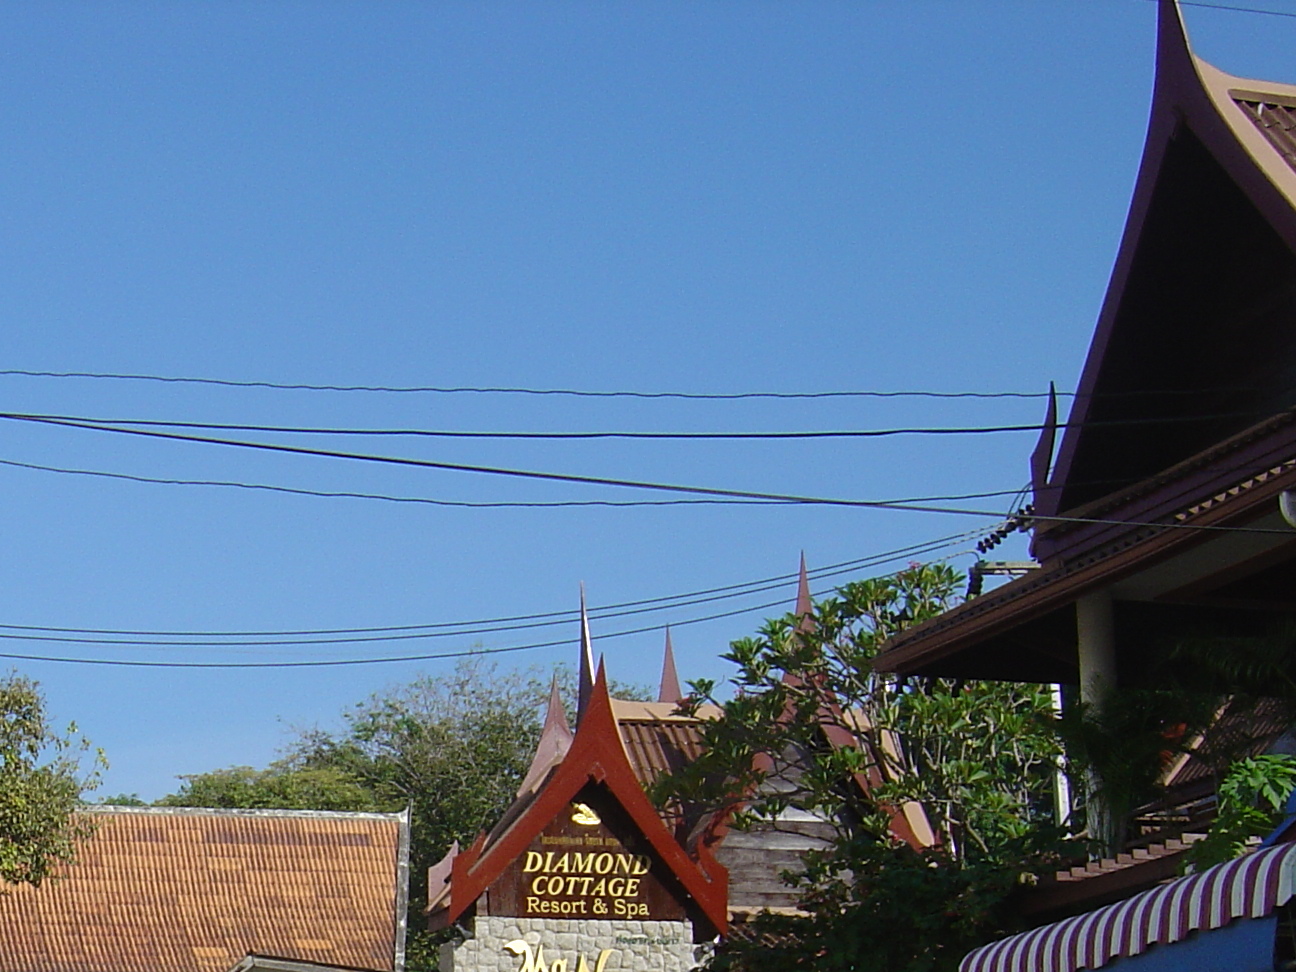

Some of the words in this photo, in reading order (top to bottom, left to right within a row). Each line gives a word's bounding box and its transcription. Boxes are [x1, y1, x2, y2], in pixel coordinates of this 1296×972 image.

[523, 851, 652, 875] DIAMOND
[532, 876, 641, 897] COTTAGE
[526, 896, 587, 914] Resort
[592, 898, 609, 914] &
[614, 898, 650, 919] Spa
